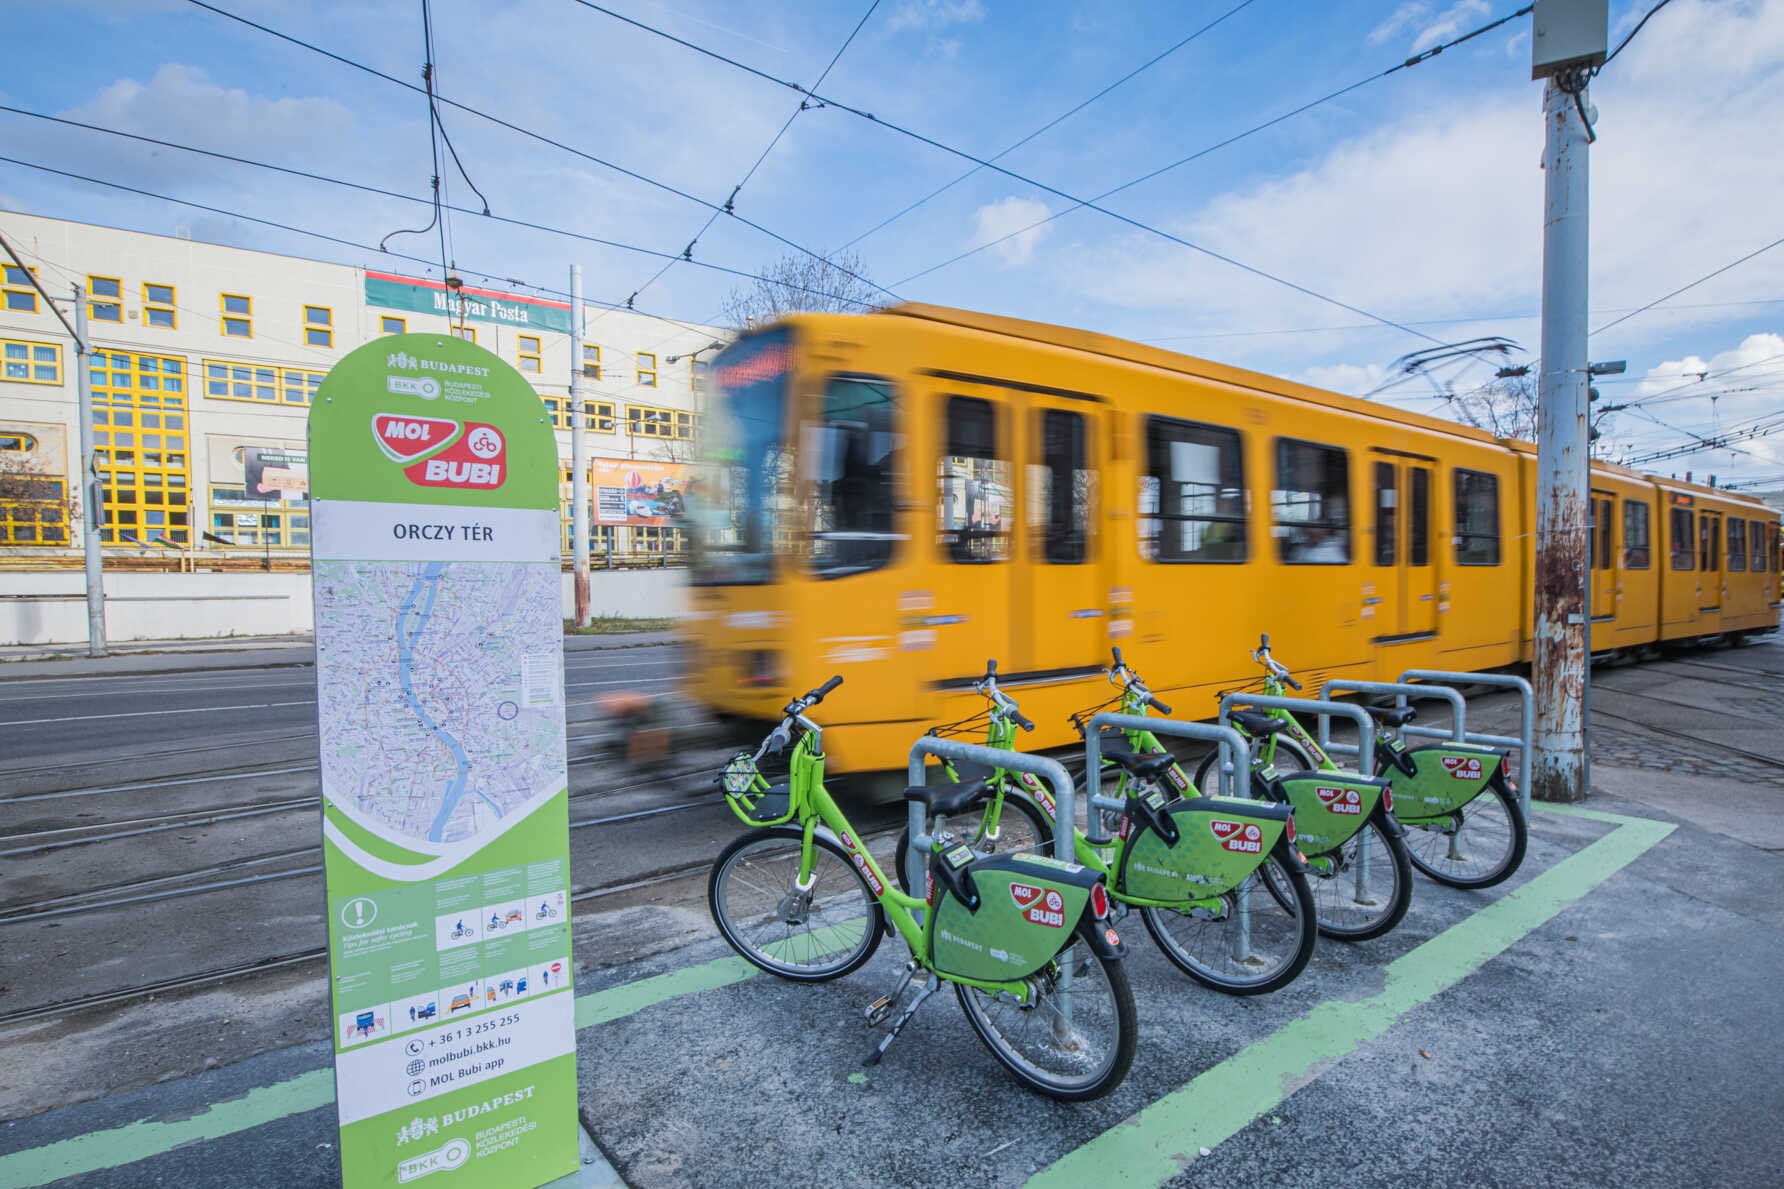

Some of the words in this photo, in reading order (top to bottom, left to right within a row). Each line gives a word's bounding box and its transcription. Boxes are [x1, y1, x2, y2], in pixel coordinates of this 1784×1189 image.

[434, 292, 488, 318] Magyar
[491, 301, 528, 322] Posta
[421, 360, 490, 377] BUDAPEST
[395, 380, 417, 390] BKK
[384, 420, 432, 440] MOL
[425, 460, 500, 484] BUBI
[393, 523, 455, 541] ORCZY
[461, 522, 493, 541] TÉR
[1456, 770, 1481, 778] BUBI
[1333, 804, 1360, 814] BUBI
[1214, 822, 1231, 833] MOL
[1229, 839, 1261, 852] BUBI
[861, 865, 882, 892] BUBI
[1014, 886, 1032, 898] MOL
[1030, 908, 1063, 926] BUBI
[428, 1039, 436, 1047] +
[438, 1032, 453, 1045] 36
[457, 1030, 463, 1040] 1
[466, 1027, 472, 1037] 3
[475, 1021, 497, 1034] 255
[500, 1013, 521, 1028] 255
[428, 1035, 512, 1068] molbubi.bkk.hu
[430, 1072, 455, 1087] MOL
[458, 1062, 482, 1079] Bubi
[485, 1057, 504, 1074] app
[442, 1085, 536, 1128] BUDAPEST
[475, 1115, 527, 1140] BUDAPESTI
[476, 1120, 537, 1150] KÖZLEKEDÉSI
[476, 1136, 519, 1160] KÖZPONT
[408, 1157, 438, 1175] BKK
